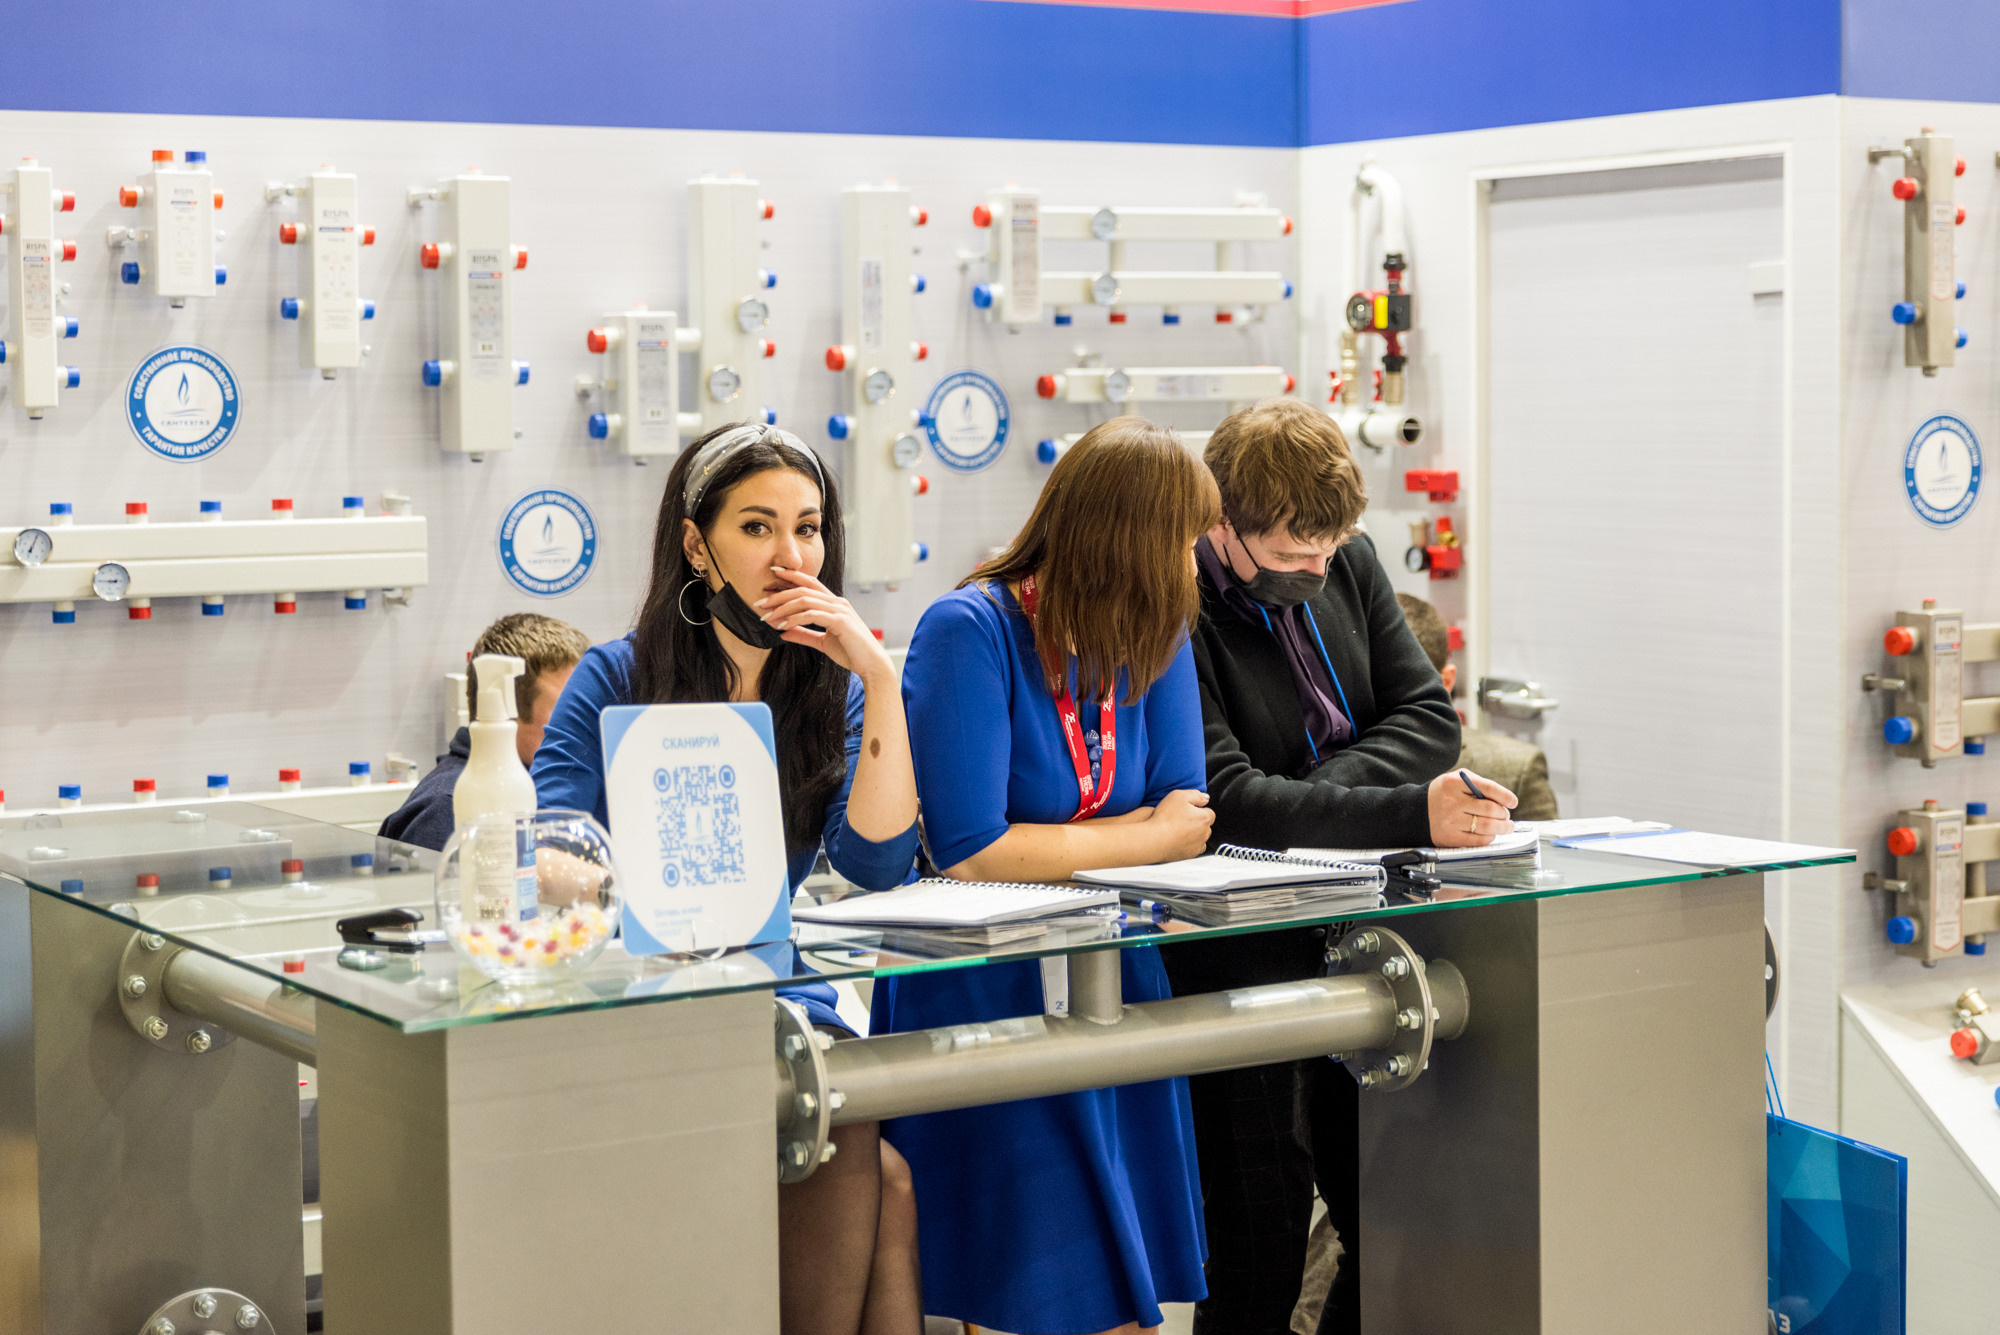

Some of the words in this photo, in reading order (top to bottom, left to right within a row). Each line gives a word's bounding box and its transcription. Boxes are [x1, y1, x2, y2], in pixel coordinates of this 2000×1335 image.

[133, 351, 179, 400] СОБСТВЕННОЕ
[180, 350, 235, 401] ПРОИЗВОДСТВО
[142, 426, 185, 455] ГАРАНТИЯ
[186, 426, 228, 455] КАЧЕСТВА
[662, 733, 719, 750] СКАНИРУЙ
